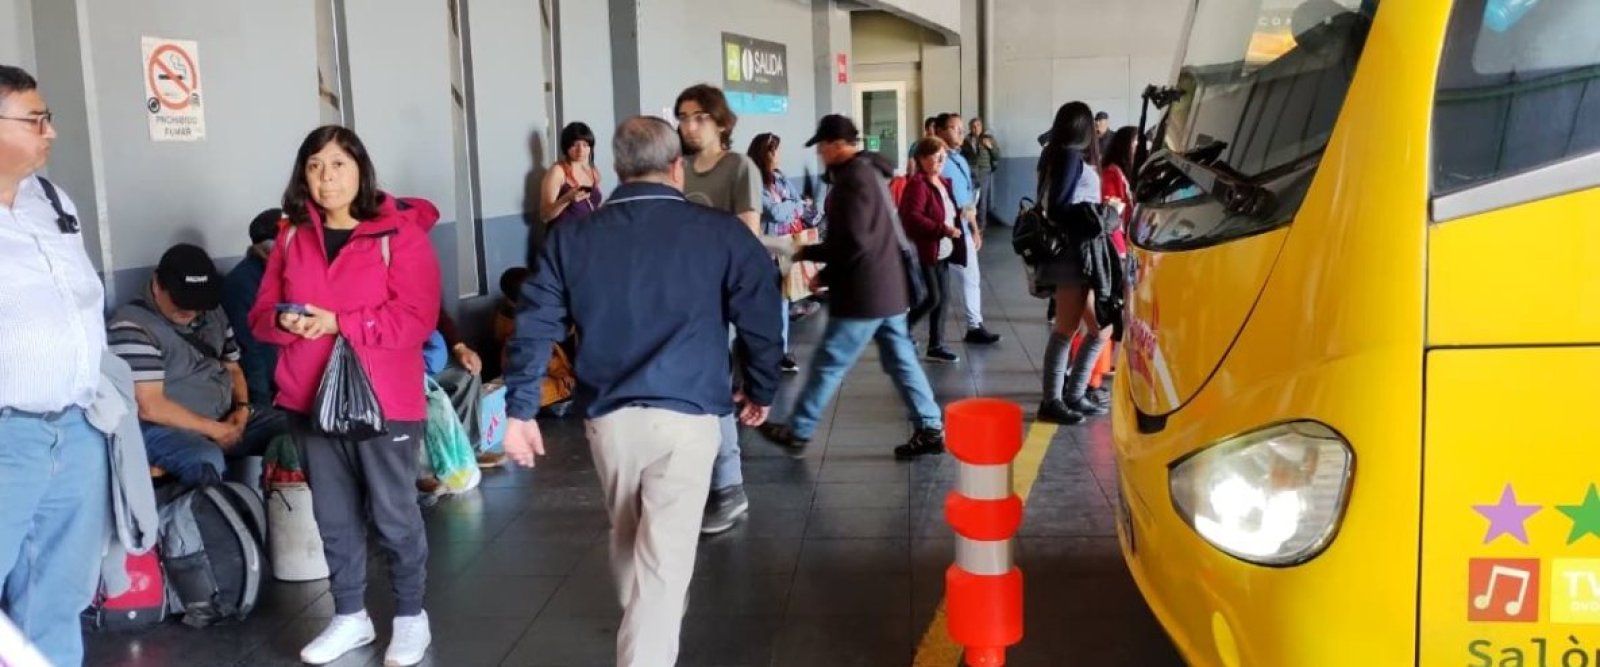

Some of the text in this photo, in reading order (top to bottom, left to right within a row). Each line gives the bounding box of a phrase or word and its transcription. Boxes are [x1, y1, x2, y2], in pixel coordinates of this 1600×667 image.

[754, 51, 784, 77] SALIDA
[156, 115, 198, 125] PROHIBIDO
[164, 127, 192, 137] FUMAR
[1467, 634, 1600, 667] Salò
